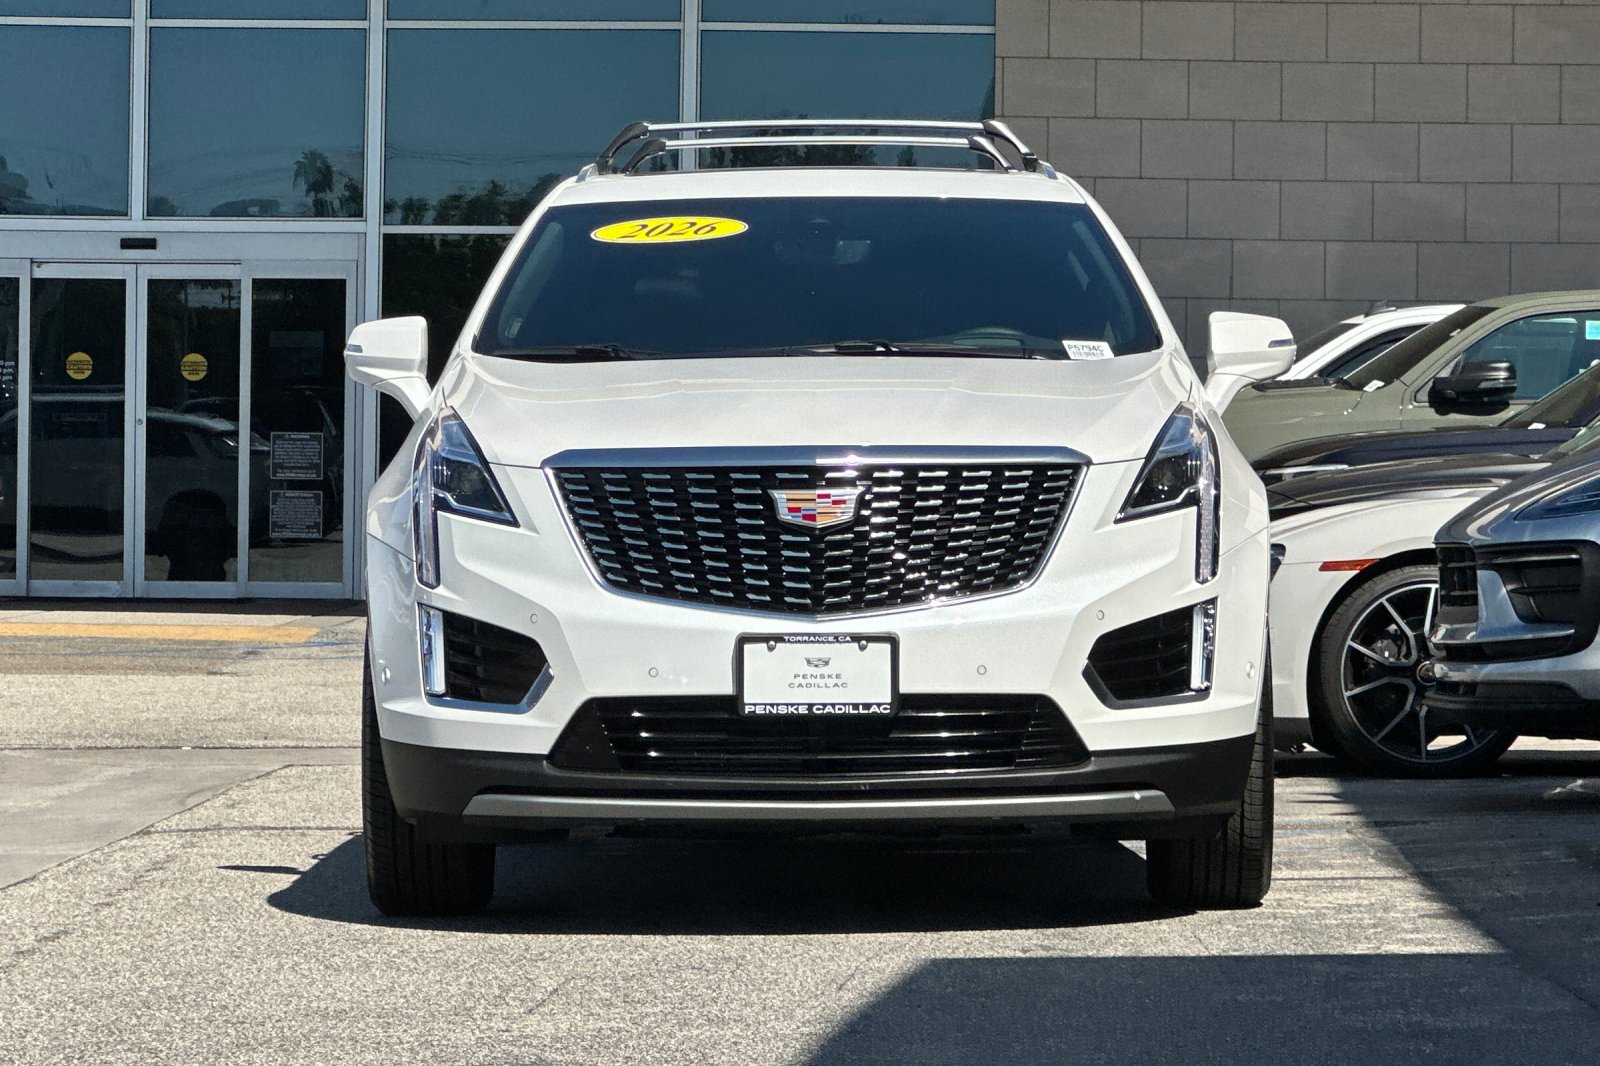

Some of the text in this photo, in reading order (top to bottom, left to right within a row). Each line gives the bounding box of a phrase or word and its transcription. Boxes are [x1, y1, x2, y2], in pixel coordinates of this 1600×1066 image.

[617, 221, 724, 239] 2026
[745, 705, 890, 713] PENSKE CADILLAC
